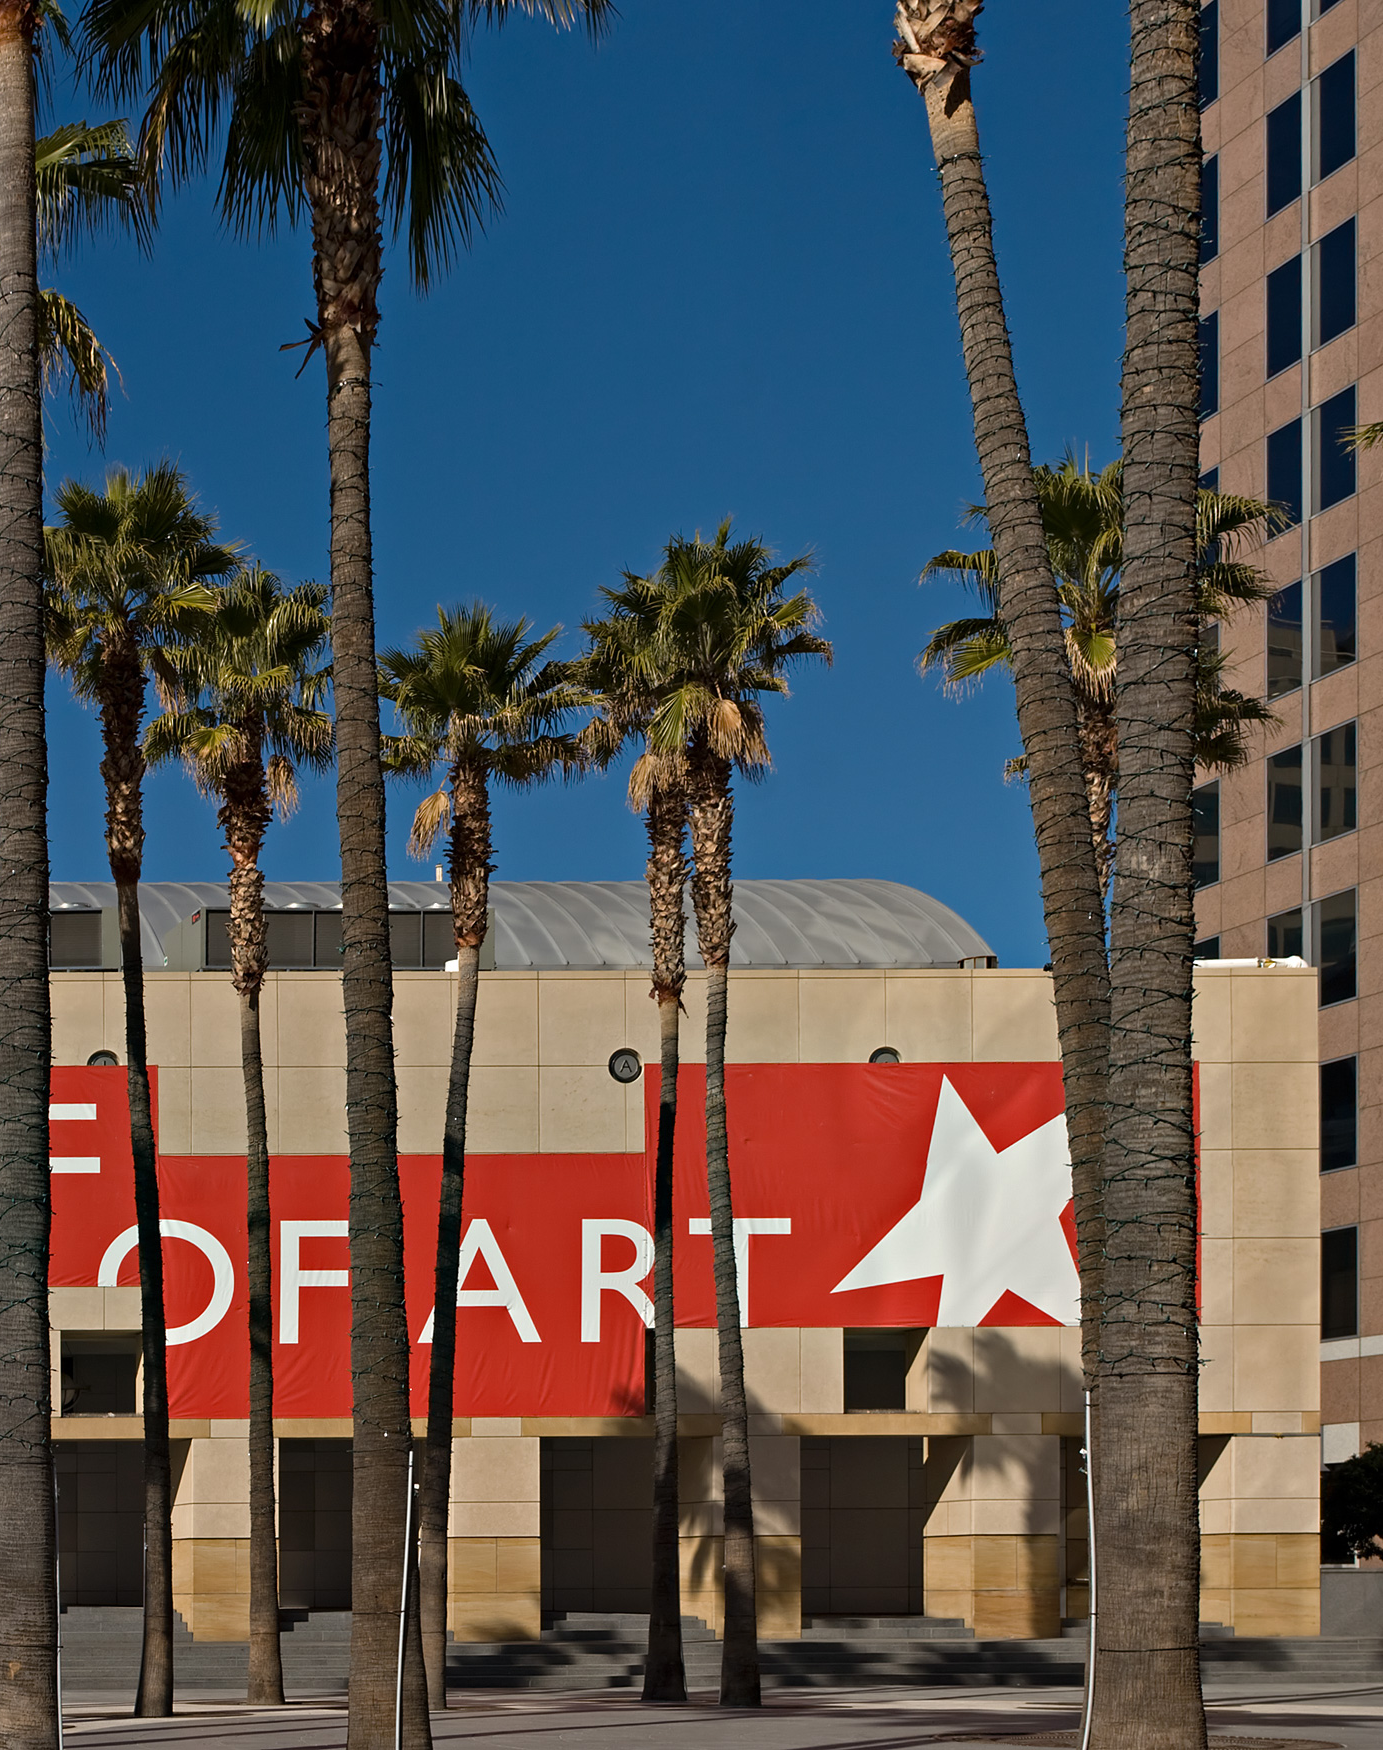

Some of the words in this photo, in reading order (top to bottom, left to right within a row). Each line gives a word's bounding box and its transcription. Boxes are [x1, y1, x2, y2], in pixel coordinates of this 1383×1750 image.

[619, 1059, 633, 1073] A
[97, 1218, 350, 1346] OF
[416, 1217, 793, 1344] ART
